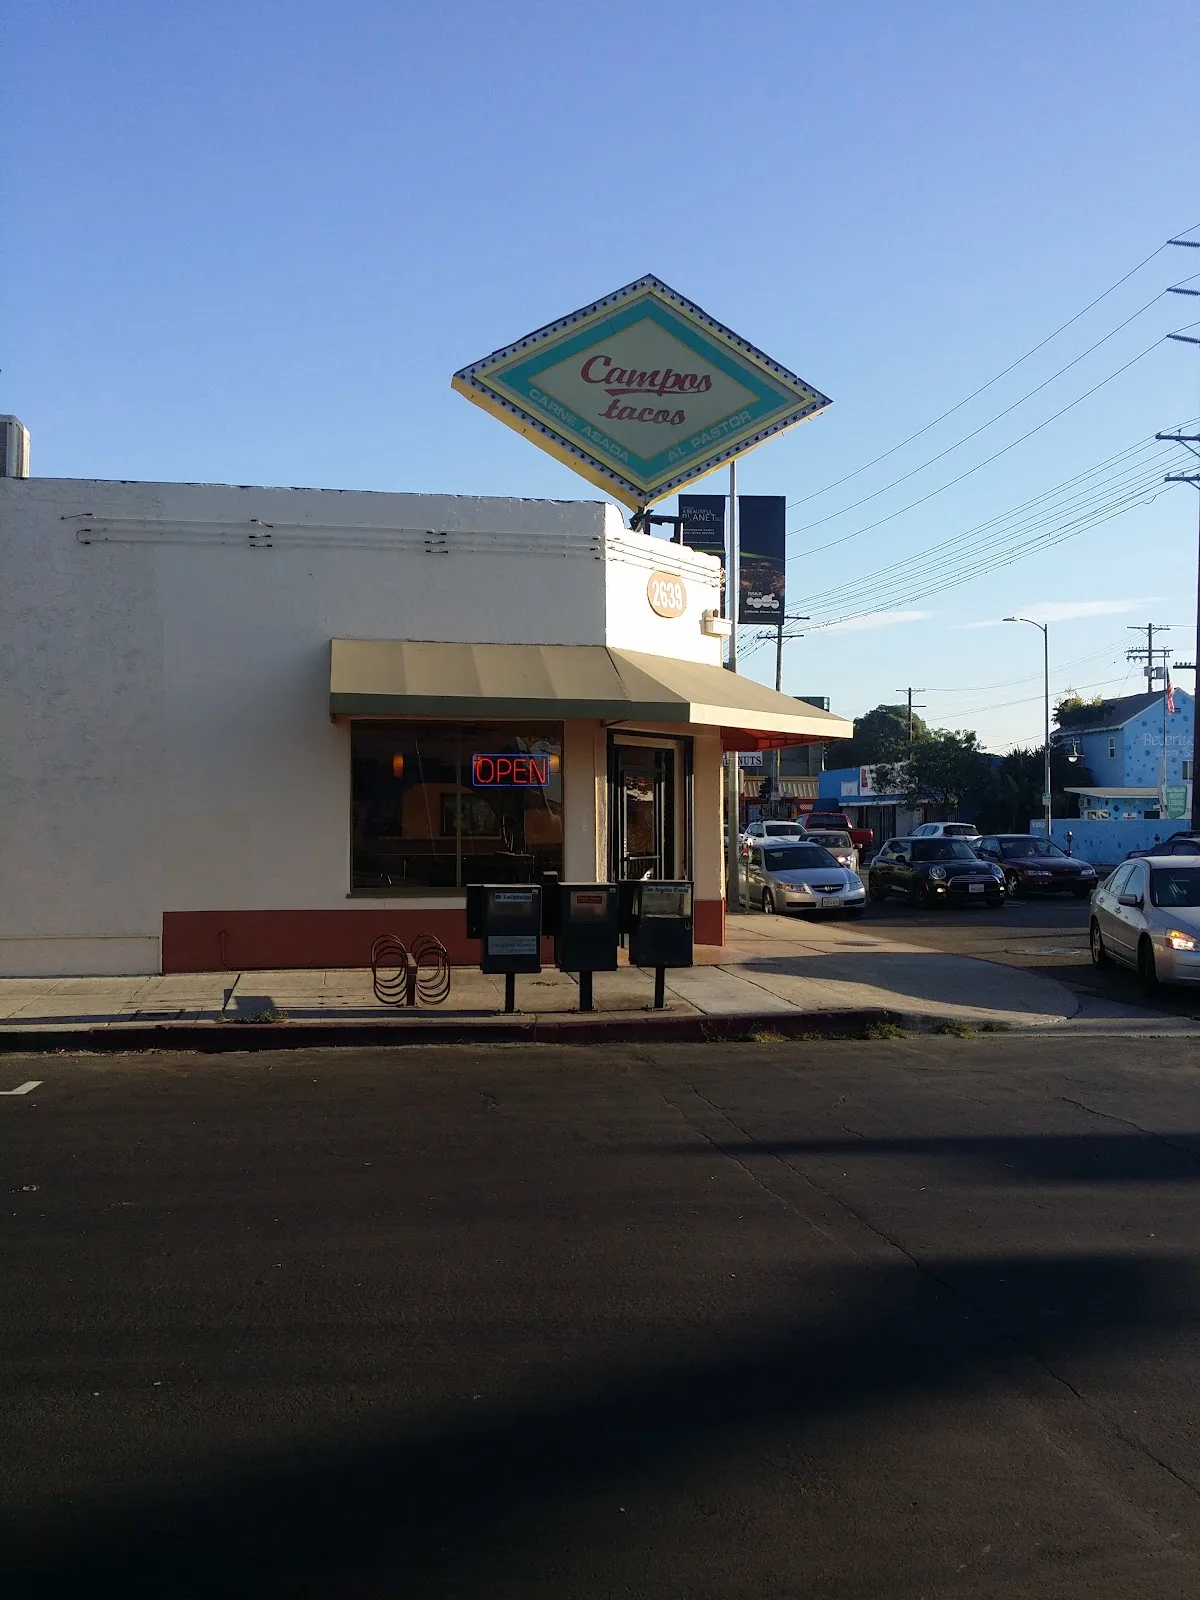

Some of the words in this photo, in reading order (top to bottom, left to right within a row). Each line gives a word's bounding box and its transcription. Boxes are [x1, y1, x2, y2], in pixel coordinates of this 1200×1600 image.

[581, 355, 712, 396] Campos
[529, 388, 577, 427] CARNE
[581, 425, 629, 463] ASADA
[598, 398, 686, 426] tacos
[668, 447, 686, 464] AL
[690, 411, 752, 449] PASTOR
[682, 513, 716, 522] PLANET
[652, 579, 683, 610] 2639
[475, 757, 547, 784] OPEN
[724, 755, 762, 766] NUTS
